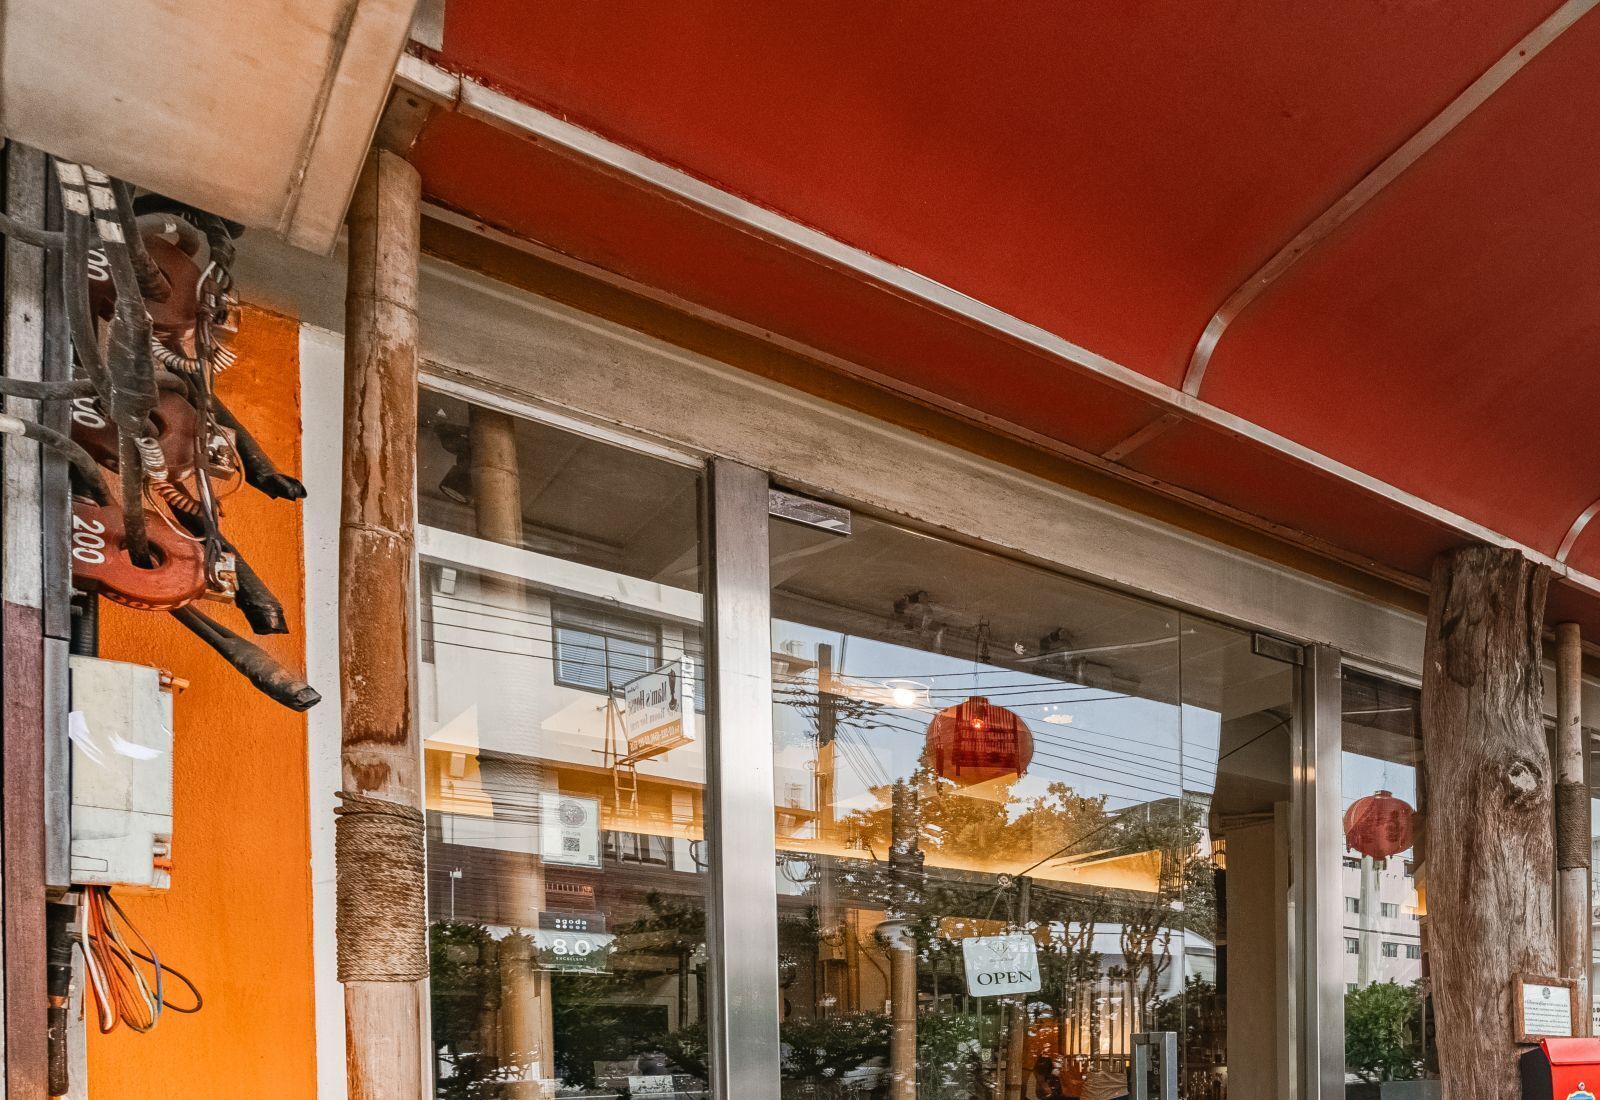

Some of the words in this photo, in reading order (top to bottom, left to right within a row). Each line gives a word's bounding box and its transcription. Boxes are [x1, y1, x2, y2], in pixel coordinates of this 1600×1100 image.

[72, 516, 106, 564] 200
[555, 918, 587, 926] agoda
[552, 938, 590, 956] 8.0
[977, 970, 1033, 986] OPEN
